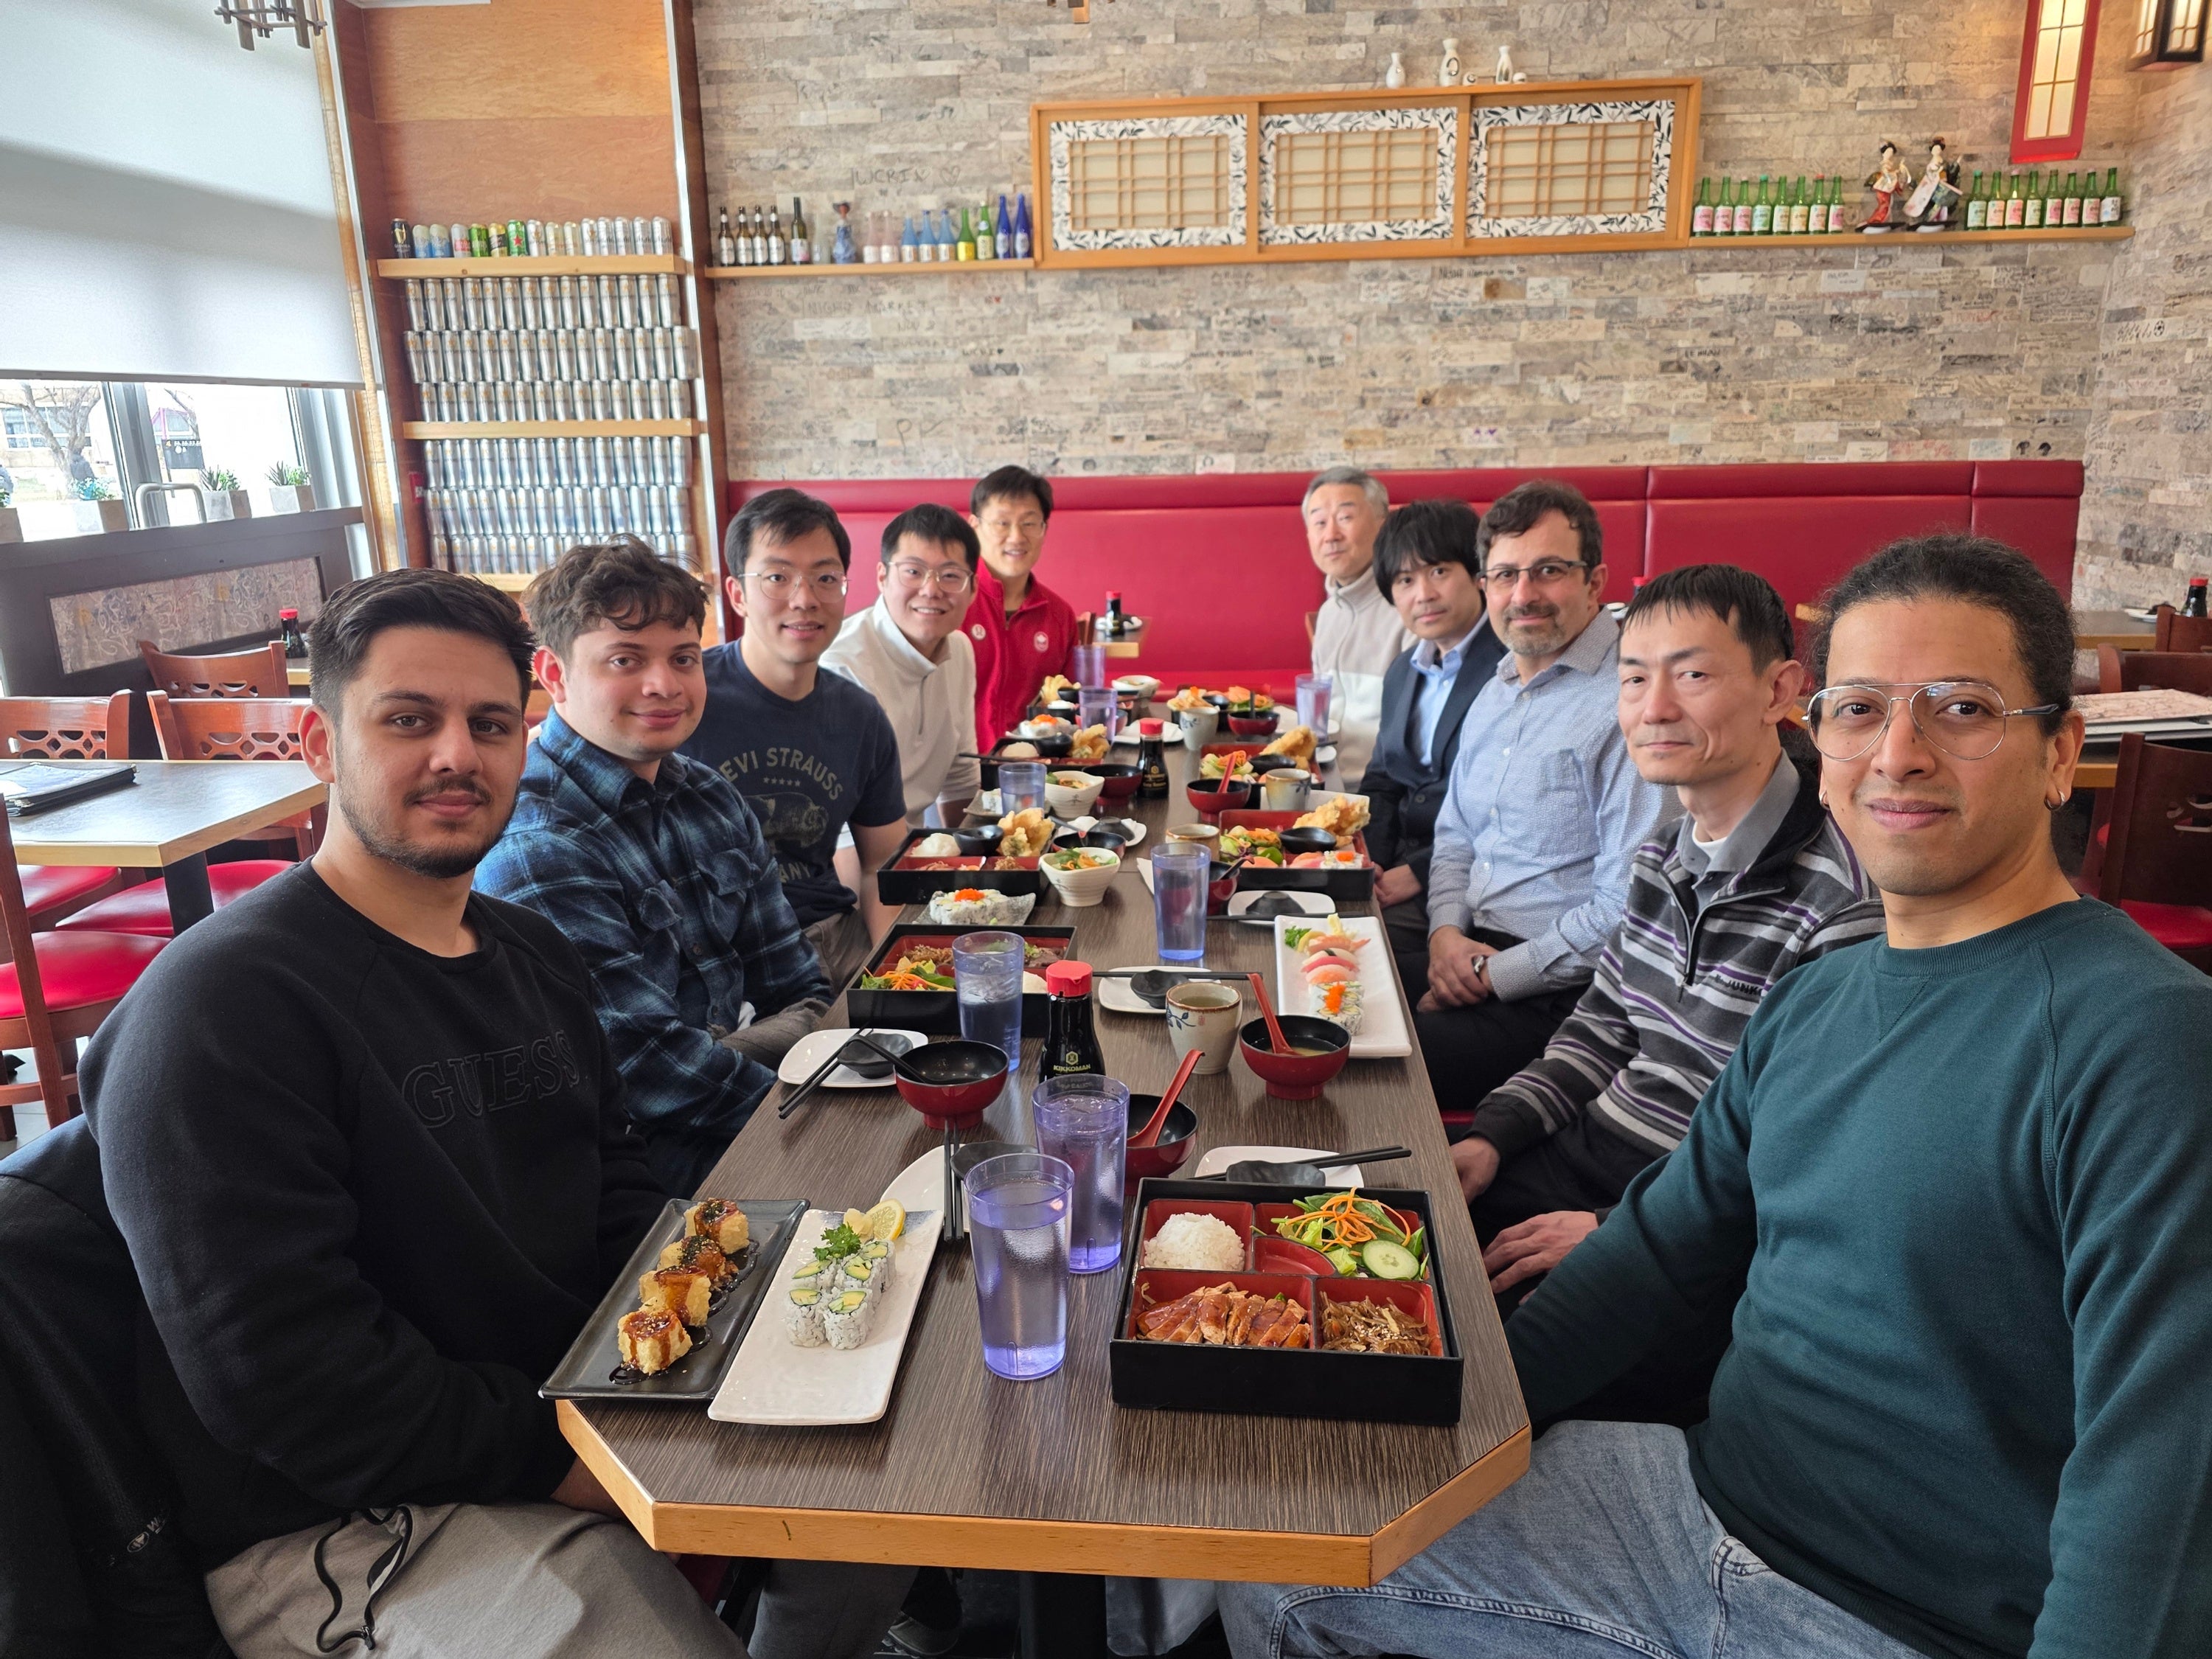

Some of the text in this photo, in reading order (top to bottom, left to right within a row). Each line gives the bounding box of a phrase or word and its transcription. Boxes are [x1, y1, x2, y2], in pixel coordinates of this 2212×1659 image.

[719, 747, 844, 801] EVI STRAUSS
[778, 861, 812, 883] ANY
[401, 1029, 580, 1129] GUESS
[1053, 1063, 1091, 1073] KIKKOMAN
